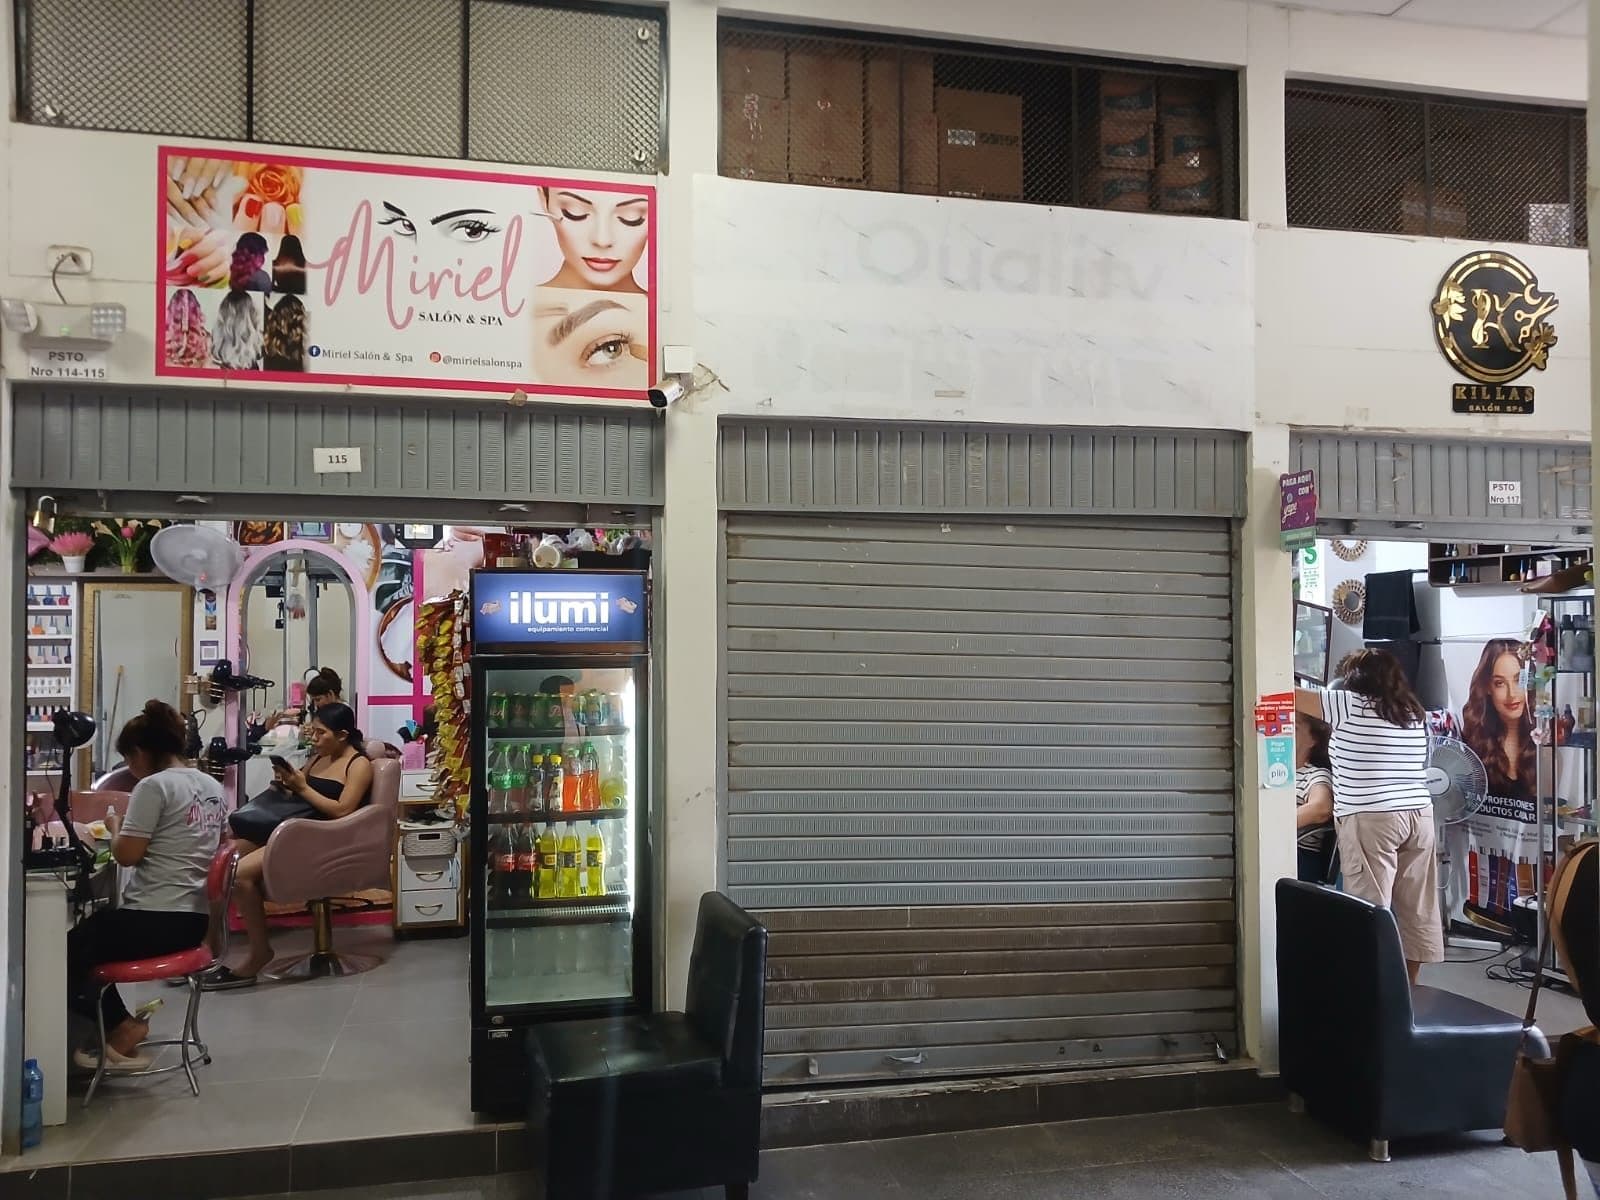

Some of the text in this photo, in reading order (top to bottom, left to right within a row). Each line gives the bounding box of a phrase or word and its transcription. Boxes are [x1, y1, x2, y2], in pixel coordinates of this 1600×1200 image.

[304, 199, 525, 330] Miriel
[418, 310, 503, 326] SALÓN & SPA
[322, 349, 413, 364] Miriel Salón & Spa
[442, 354, 522, 369] @mirielsalonspa
[31, 367, 105, 378] Nro 114-115
[1455, 386, 1533, 402] KILLAS
[328, 454, 348, 464] 115
[1492, 483, 1515, 491] PSTO
[1490, 495, 1520, 504] Nro 117
[509, 591, 609, 624] ilumi
[527, 625, 609, 634] equipamiento comercial
[1271, 768, 1286, 779] plin
